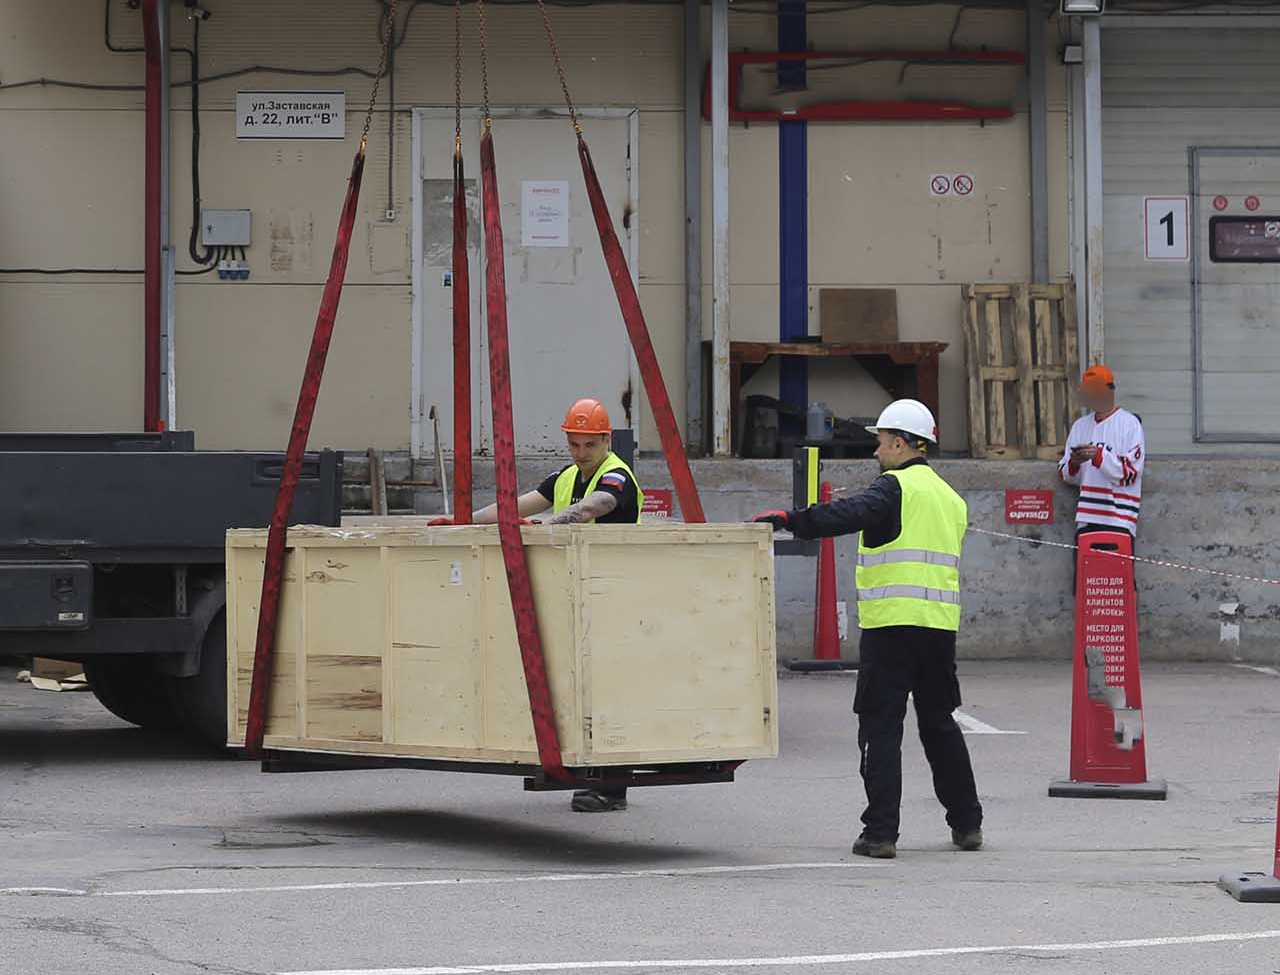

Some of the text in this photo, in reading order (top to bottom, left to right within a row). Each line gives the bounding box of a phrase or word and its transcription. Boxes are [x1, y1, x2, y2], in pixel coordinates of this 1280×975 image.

[245, 115, 258, 126] д.
[262, 113, 282, 126] 22,
[1160, 210, 1174, 246] 1
[1086, 577, 1123, 586] МЕСТО ДЛЯ
[1087, 598, 1124, 606] КЛИЕНТОВ
[1086, 624, 1125, 632] МЕСТО ДЛЯ
[1086, 635, 1125, 643] ПАРКОВКИ
